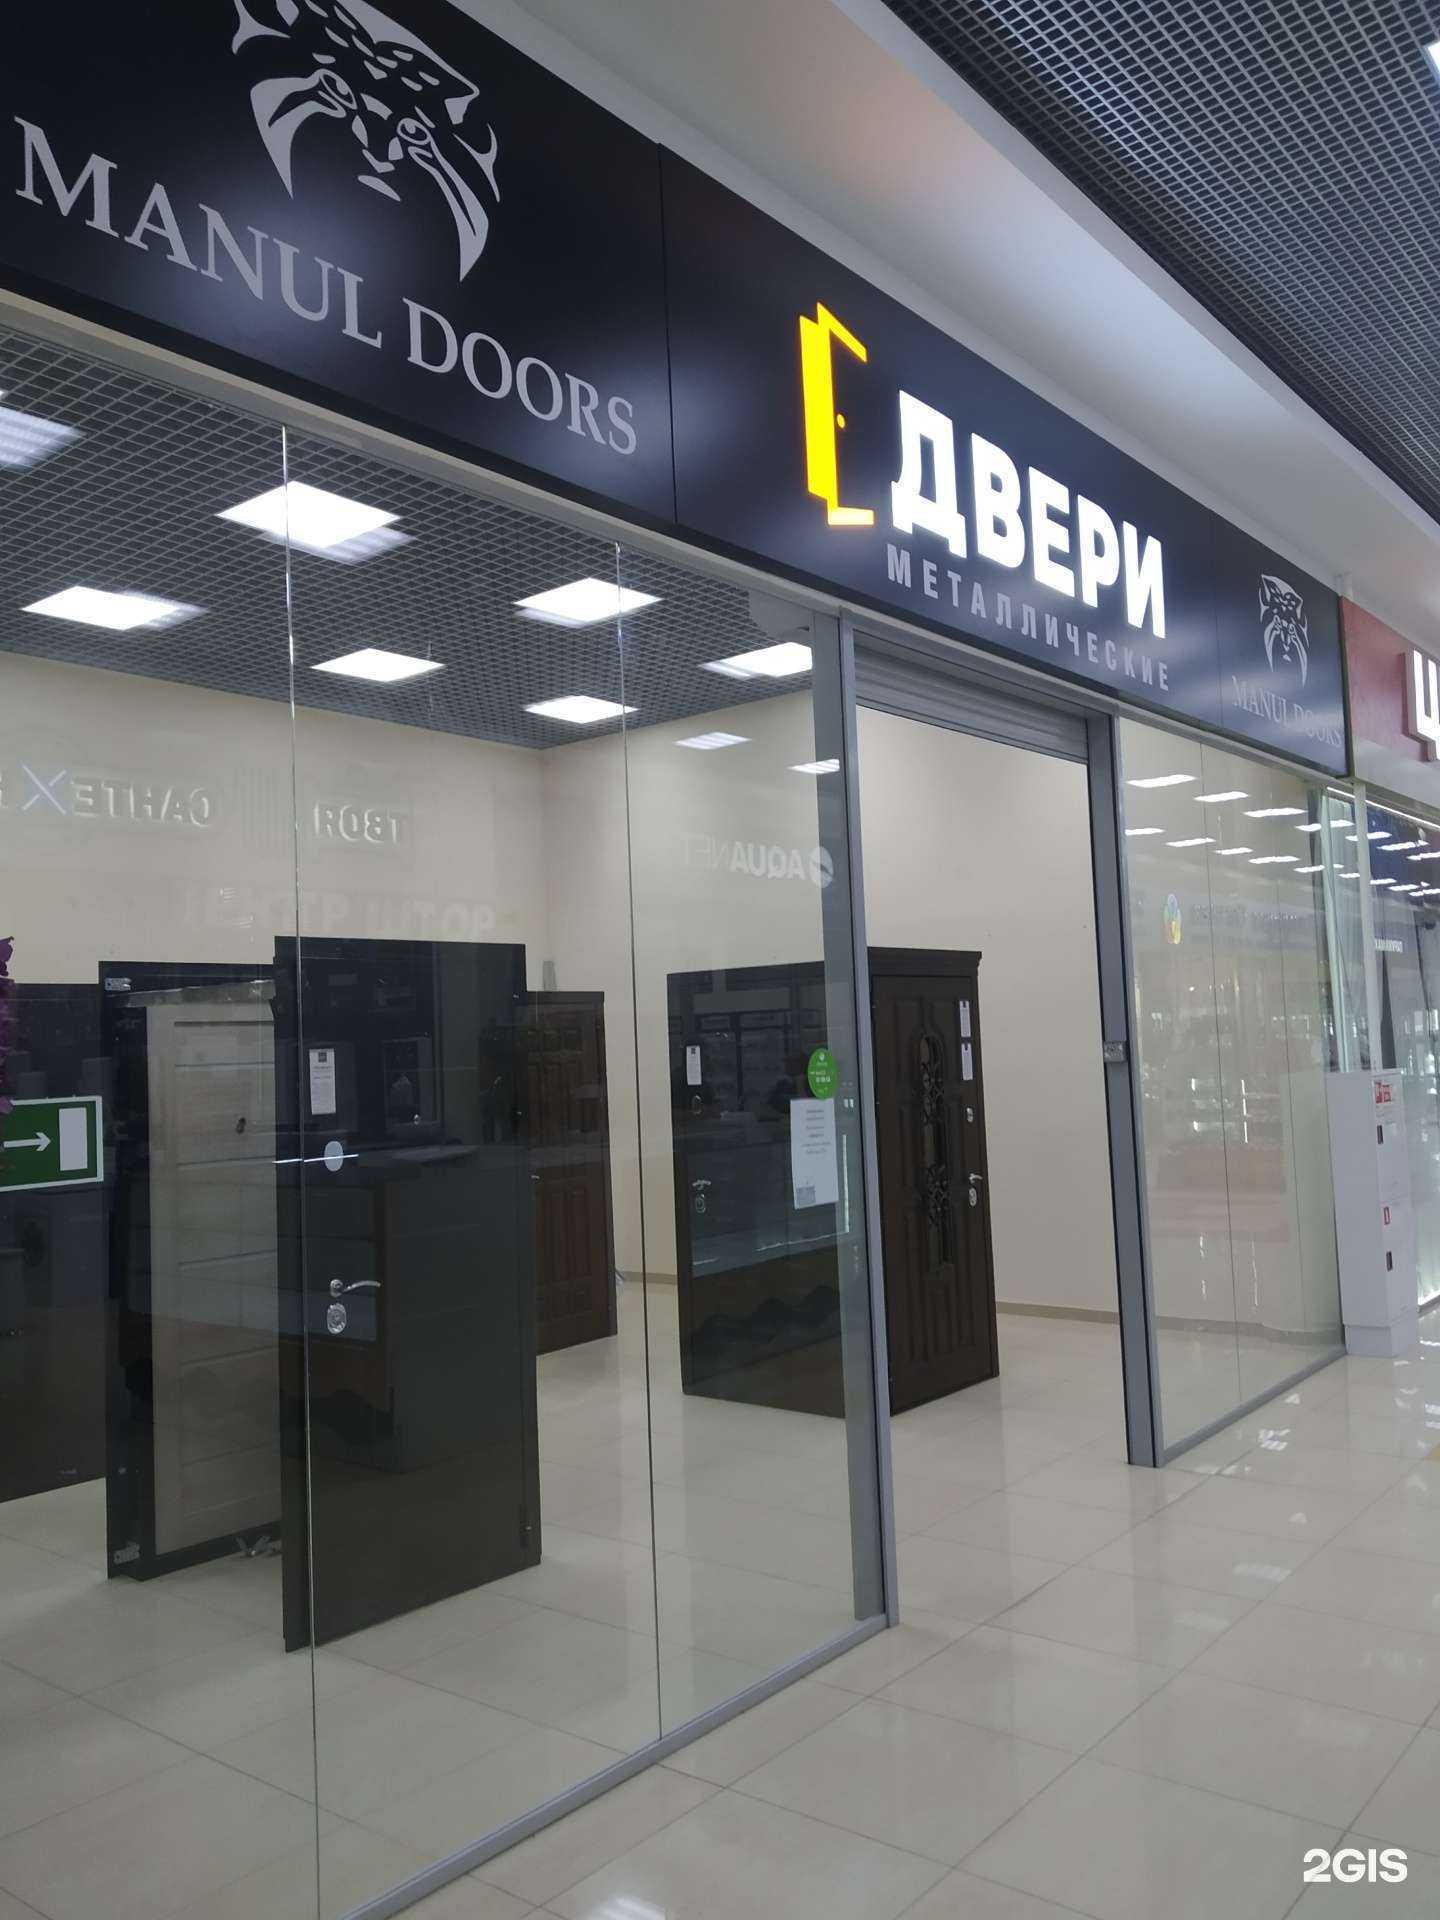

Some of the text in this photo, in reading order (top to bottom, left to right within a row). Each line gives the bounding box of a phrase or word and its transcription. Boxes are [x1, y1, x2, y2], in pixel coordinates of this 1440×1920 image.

[14, 115, 638, 455] MANUL DOORS
[891, 389, 1167, 639] ДВЕРИ
[886, 543, 1169, 692] МЕТАЛЛИЧЕСКИЕ
[1231, 674, 1288, 729] MANUL
